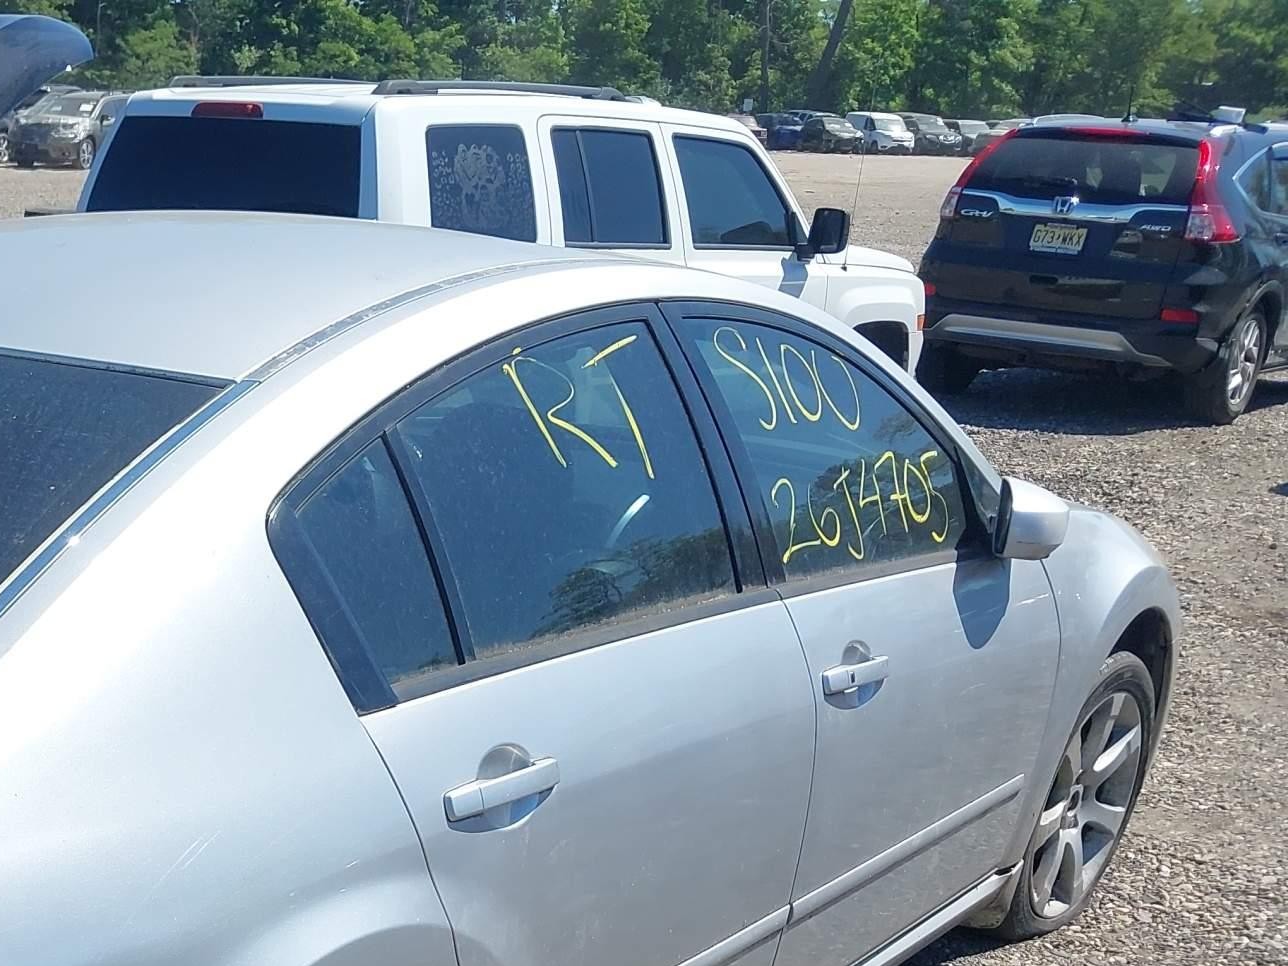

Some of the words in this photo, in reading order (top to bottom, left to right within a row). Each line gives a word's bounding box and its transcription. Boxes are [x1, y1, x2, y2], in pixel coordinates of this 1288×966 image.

[503, 334, 656, 480] RT
[713, 326, 862, 432] S100
[770, 450, 950, 564] 26J4705
